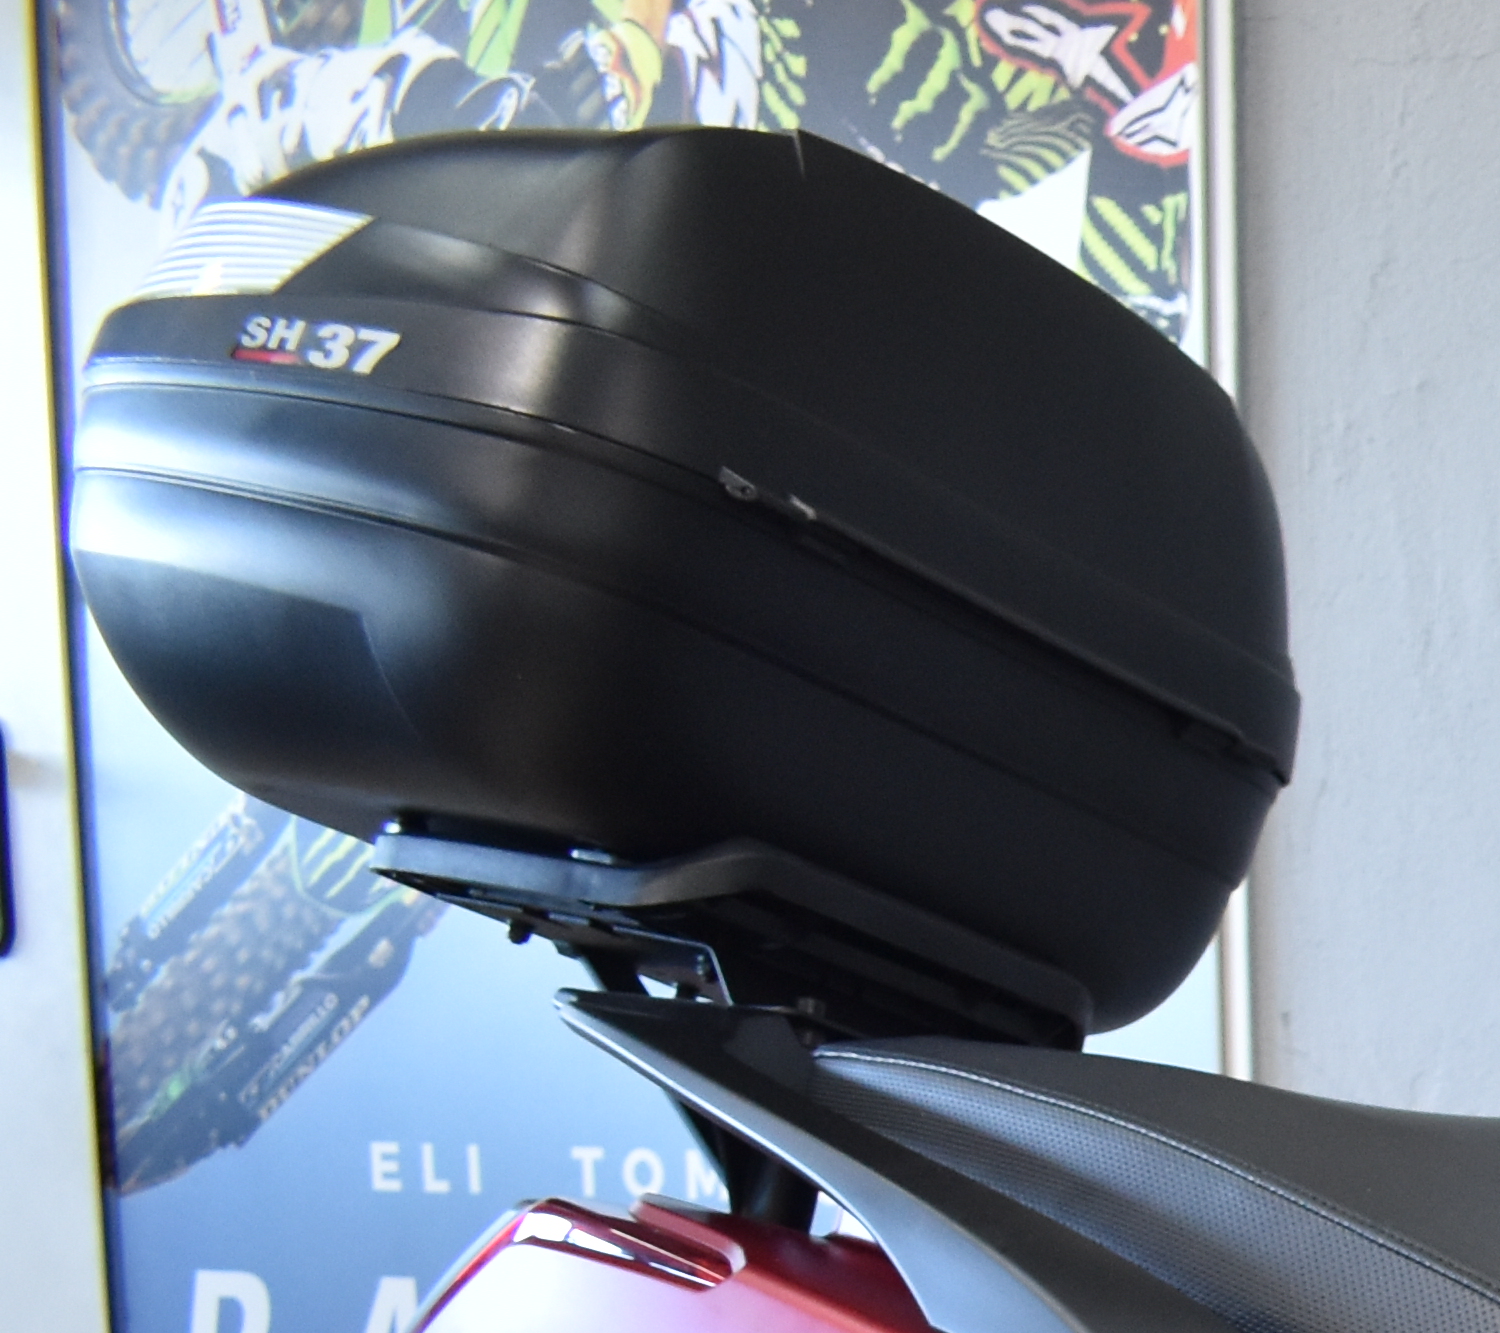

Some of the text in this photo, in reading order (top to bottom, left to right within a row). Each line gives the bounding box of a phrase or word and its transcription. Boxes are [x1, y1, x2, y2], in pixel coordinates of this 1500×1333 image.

[239, 314, 401, 375] SH 37
[370, 1141, 482, 1196] ELI
